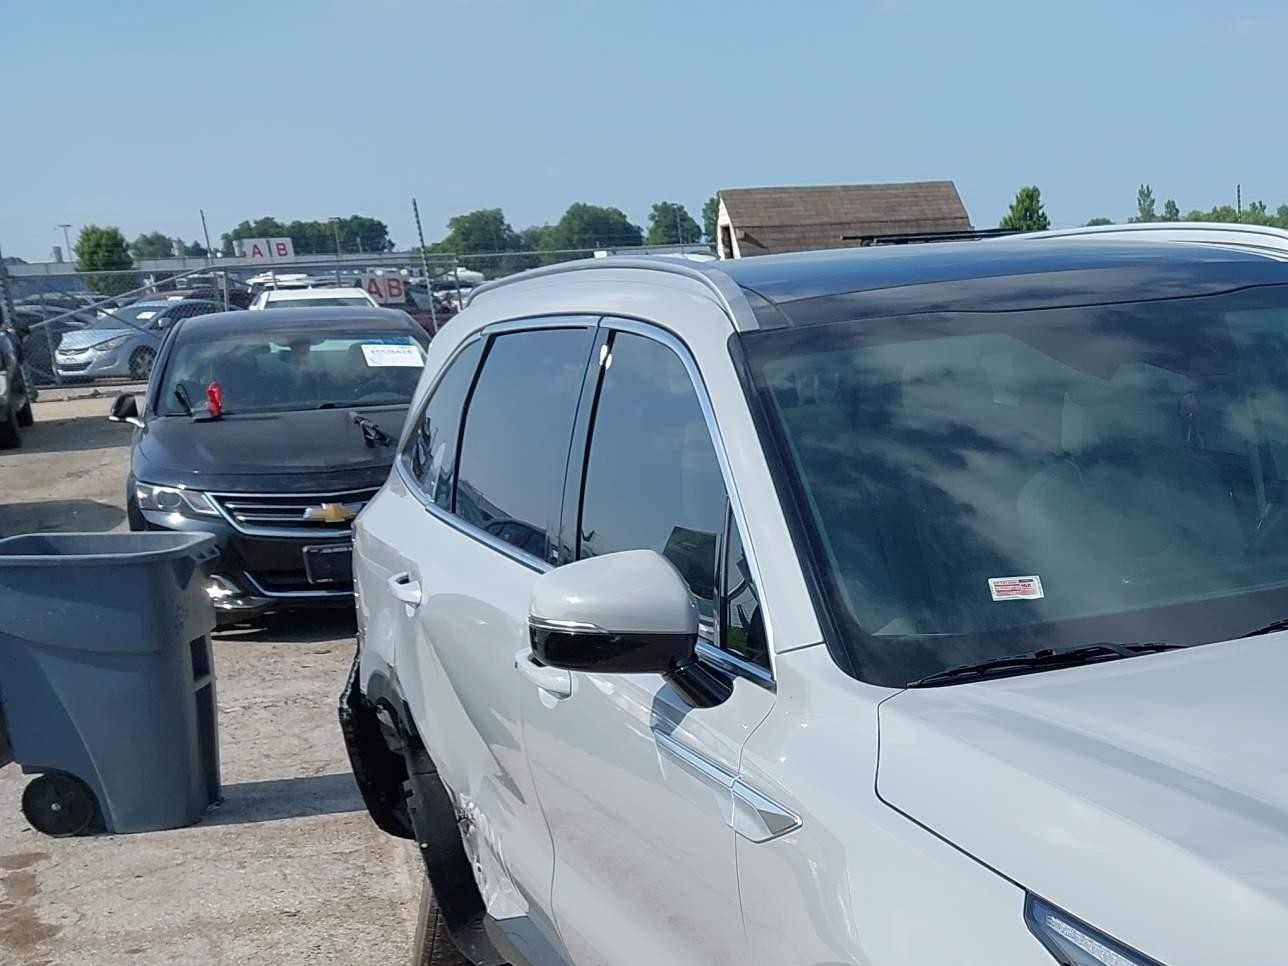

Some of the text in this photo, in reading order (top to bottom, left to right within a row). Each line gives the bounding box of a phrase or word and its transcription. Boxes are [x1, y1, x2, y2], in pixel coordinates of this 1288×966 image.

[252, 242, 288, 258] A B
[368, 278, 402, 298] A B
